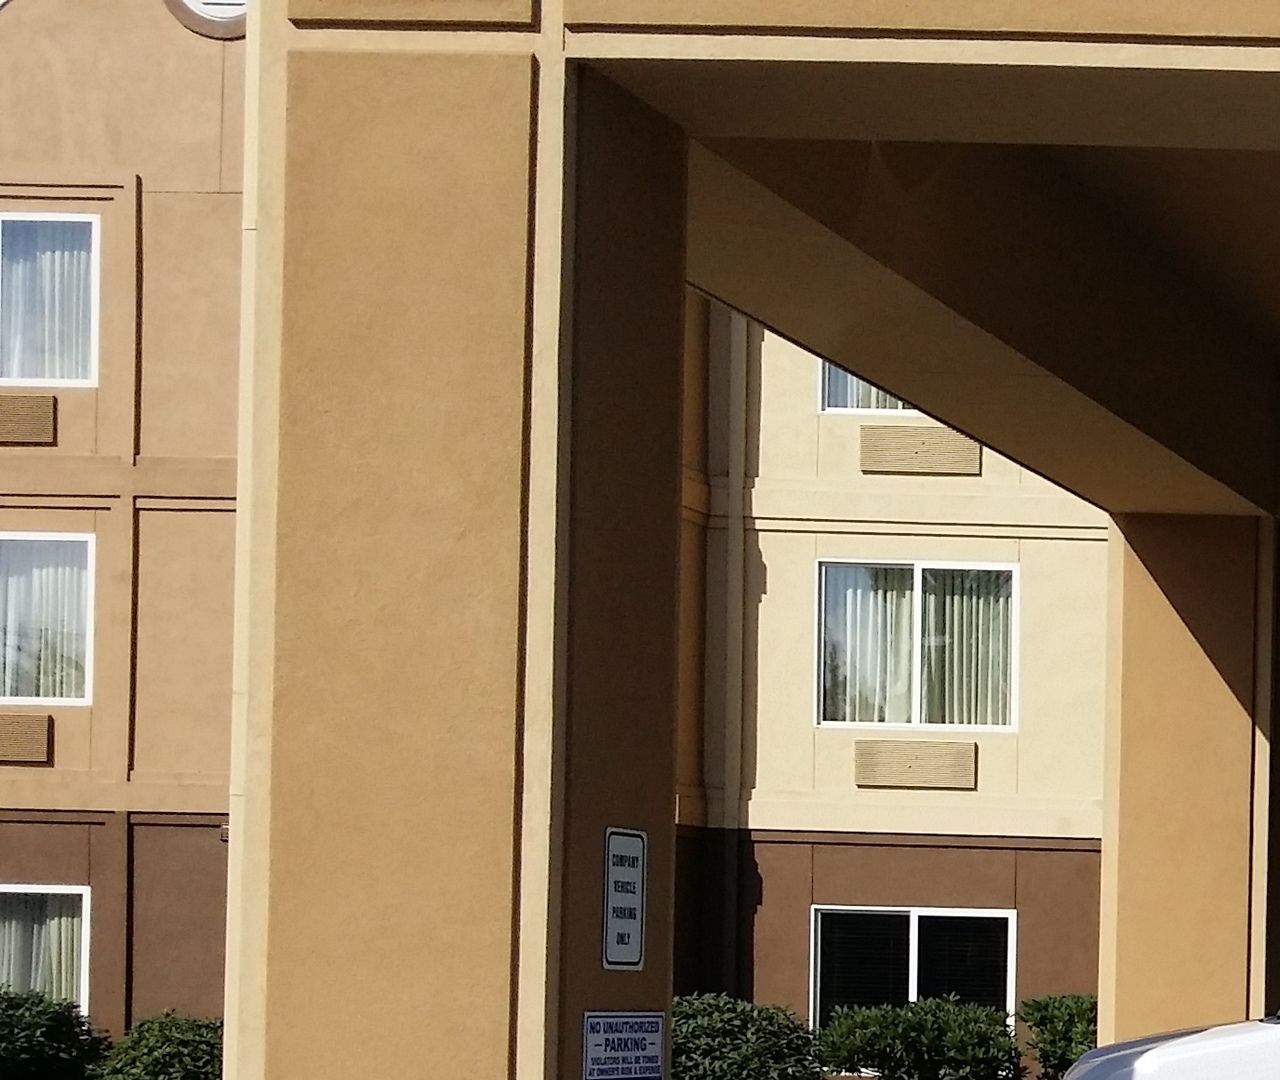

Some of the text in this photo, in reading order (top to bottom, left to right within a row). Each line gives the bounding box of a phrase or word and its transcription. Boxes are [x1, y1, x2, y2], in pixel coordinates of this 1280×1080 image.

[612, 853, 639, 869] COMPANY
[613, 879, 637, 894] VEHICLE
[611, 905, 637, 921] PARKING
[616, 932, 631, 946] ONLY
[589, 1021, 659, 1034] NO UNAUTHORIZED
[604, 1037, 647, 1053] PARKING
[591, 1055, 659, 1066] VIOLATORS WILL BE TOWED
[588, 1068, 596, 1077] AT
[621, 1066, 632, 1075] RISK
[638, 1065, 661, 1074] EXPENSE
